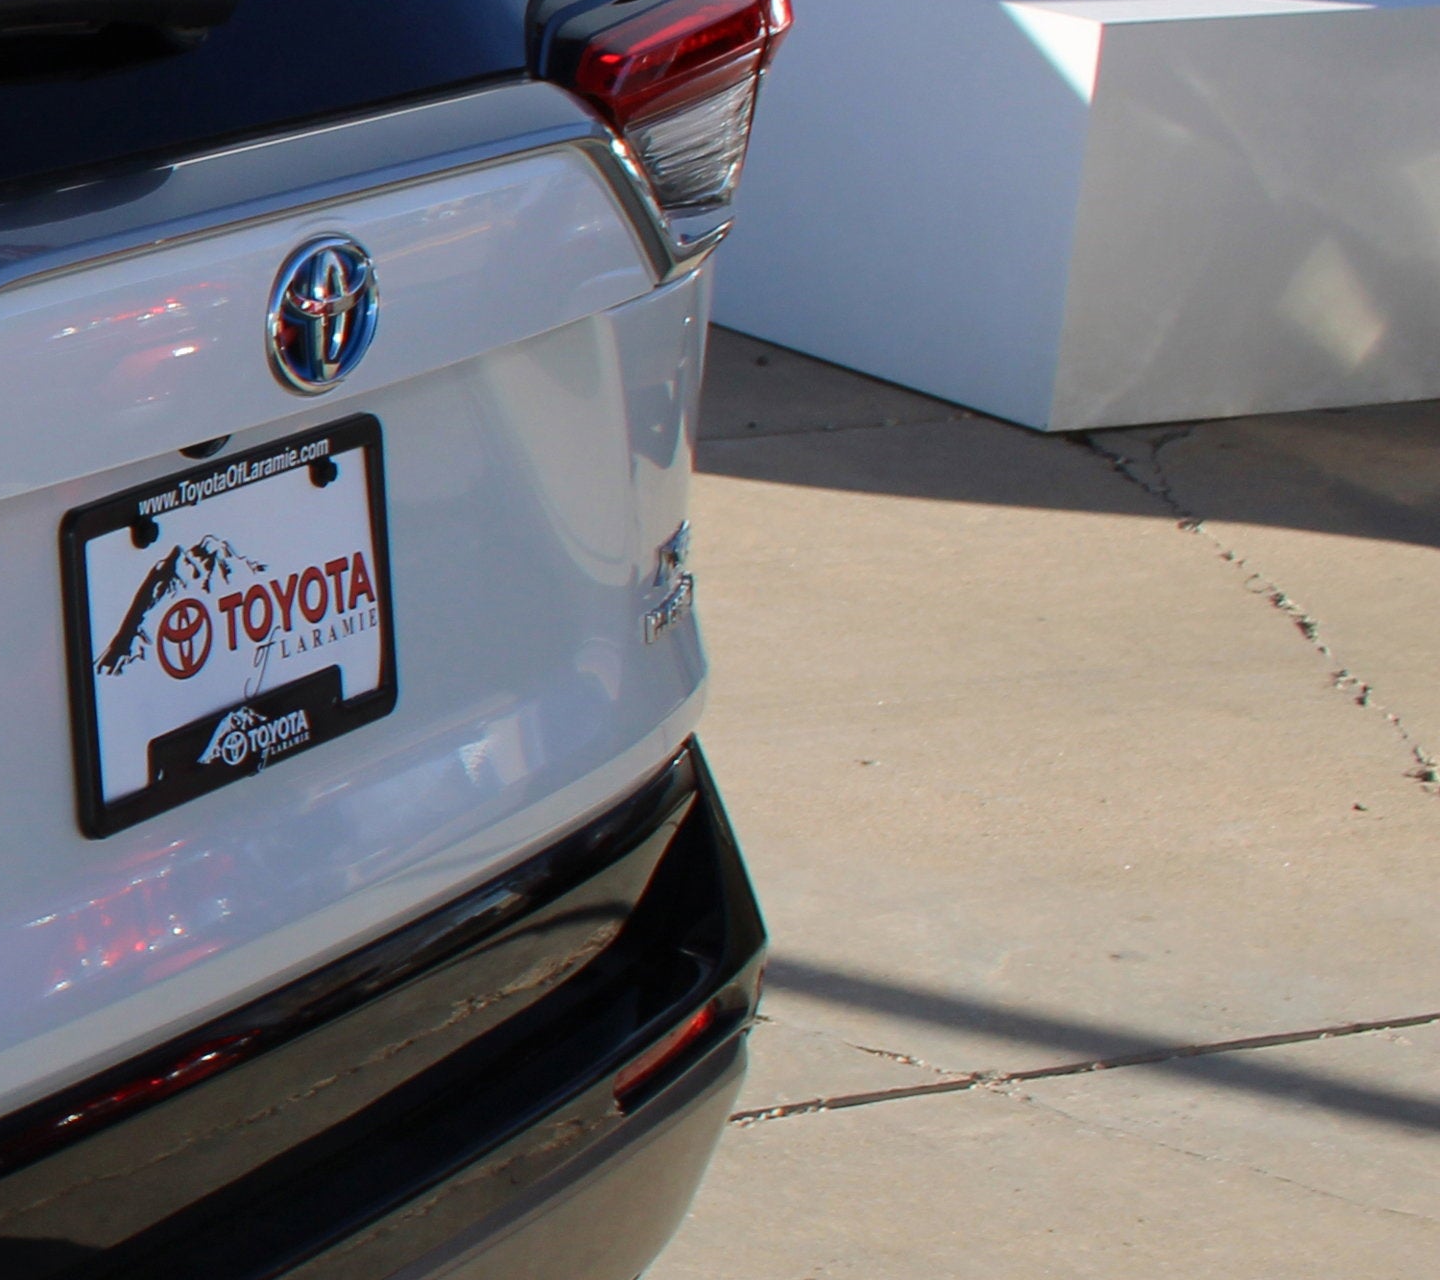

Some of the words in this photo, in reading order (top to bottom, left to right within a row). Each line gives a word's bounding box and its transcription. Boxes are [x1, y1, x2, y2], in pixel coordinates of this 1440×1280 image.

[138, 437, 329, 516] www.ToyotaOfLaramie.com
[218, 551, 376, 651] TOYOTA
[244, 625, 281, 699] of
[280, 607, 378, 660] LARAMIE
[247, 708, 309, 752] TOYOTA
[270, 731, 310, 756] LARAMIE
